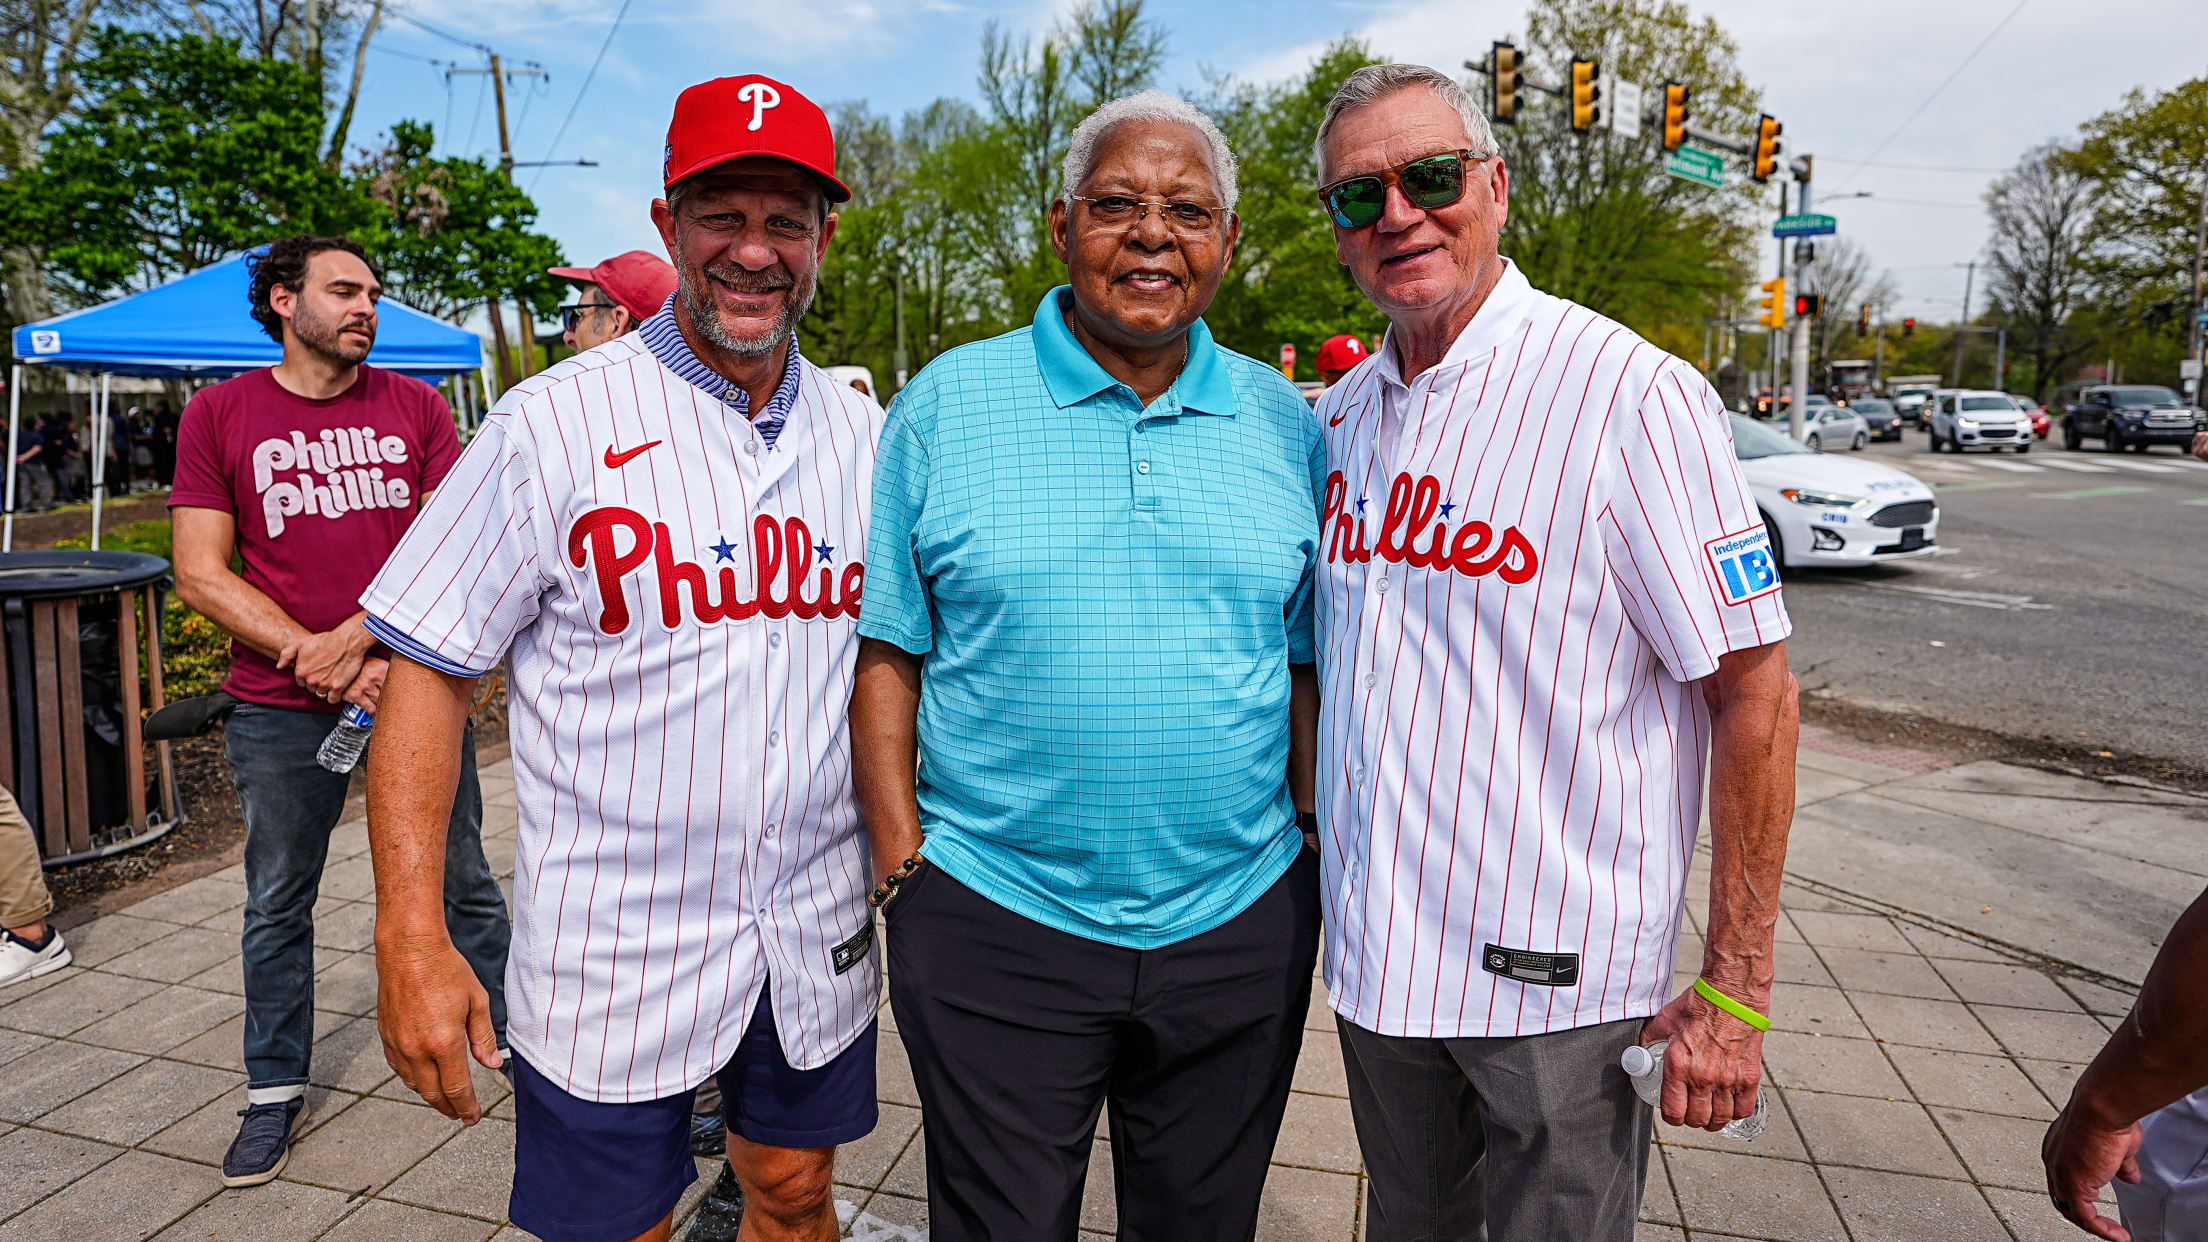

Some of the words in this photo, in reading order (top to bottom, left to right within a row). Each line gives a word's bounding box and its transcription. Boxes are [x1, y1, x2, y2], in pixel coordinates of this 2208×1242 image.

[737, 83, 781, 132] P
[253, 426, 408, 494] phillie
[263, 467, 411, 539] phillie
[1320, 470, 1539, 585] Phillies
[568, 506, 864, 634] Phillie
[1513, 953, 1551, 962] ENGINEERED
